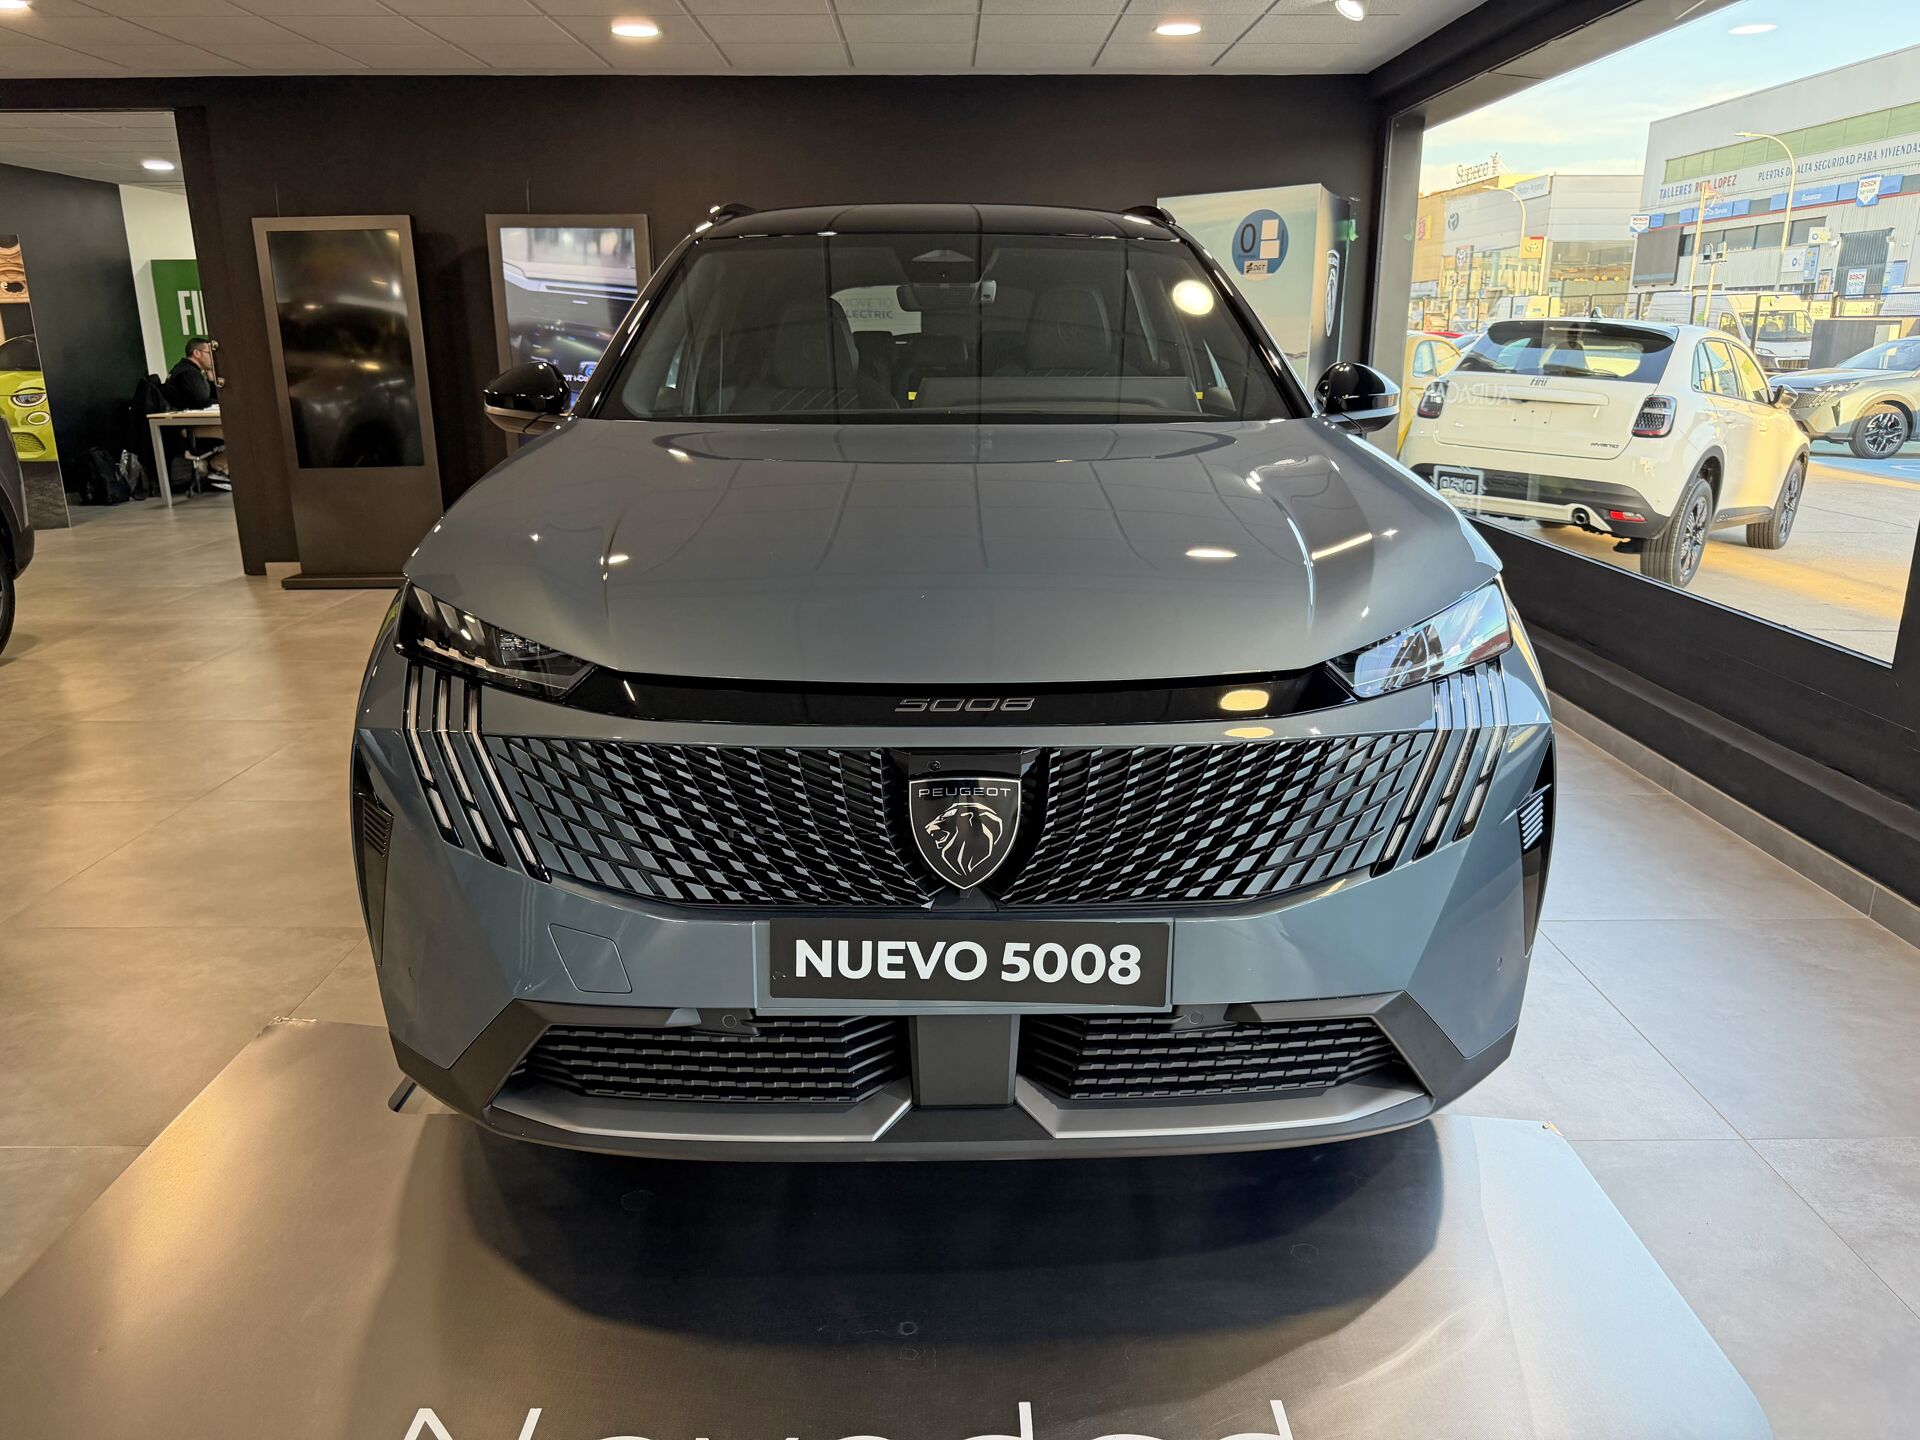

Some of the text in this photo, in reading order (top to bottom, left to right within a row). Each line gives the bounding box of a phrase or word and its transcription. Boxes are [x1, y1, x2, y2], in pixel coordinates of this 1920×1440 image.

[1757, 167, 1784, 181] PUERTAS
[1796, 162, 1812, 175] ALTA
[1814, 154, 1856, 170] SEGURIDAD
[1857, 151, 1877, 163] PARA
[1660, 183, 1693, 199] TALLERES
[1713, 175, 1738, 190] LOPEZ
[1860, 179, 1878, 188] BOSCH
[1240, 223, 1256, 253] 0
[1848, 273, 1865, 281] BOSCH
[845, 310, 894, 319] LECTRIC
[894, 697, 1035, 712] 5008
[918, 787, 1011, 798] PEUGEOT
[795, 939, 1142, 985] NUEVO 5008
